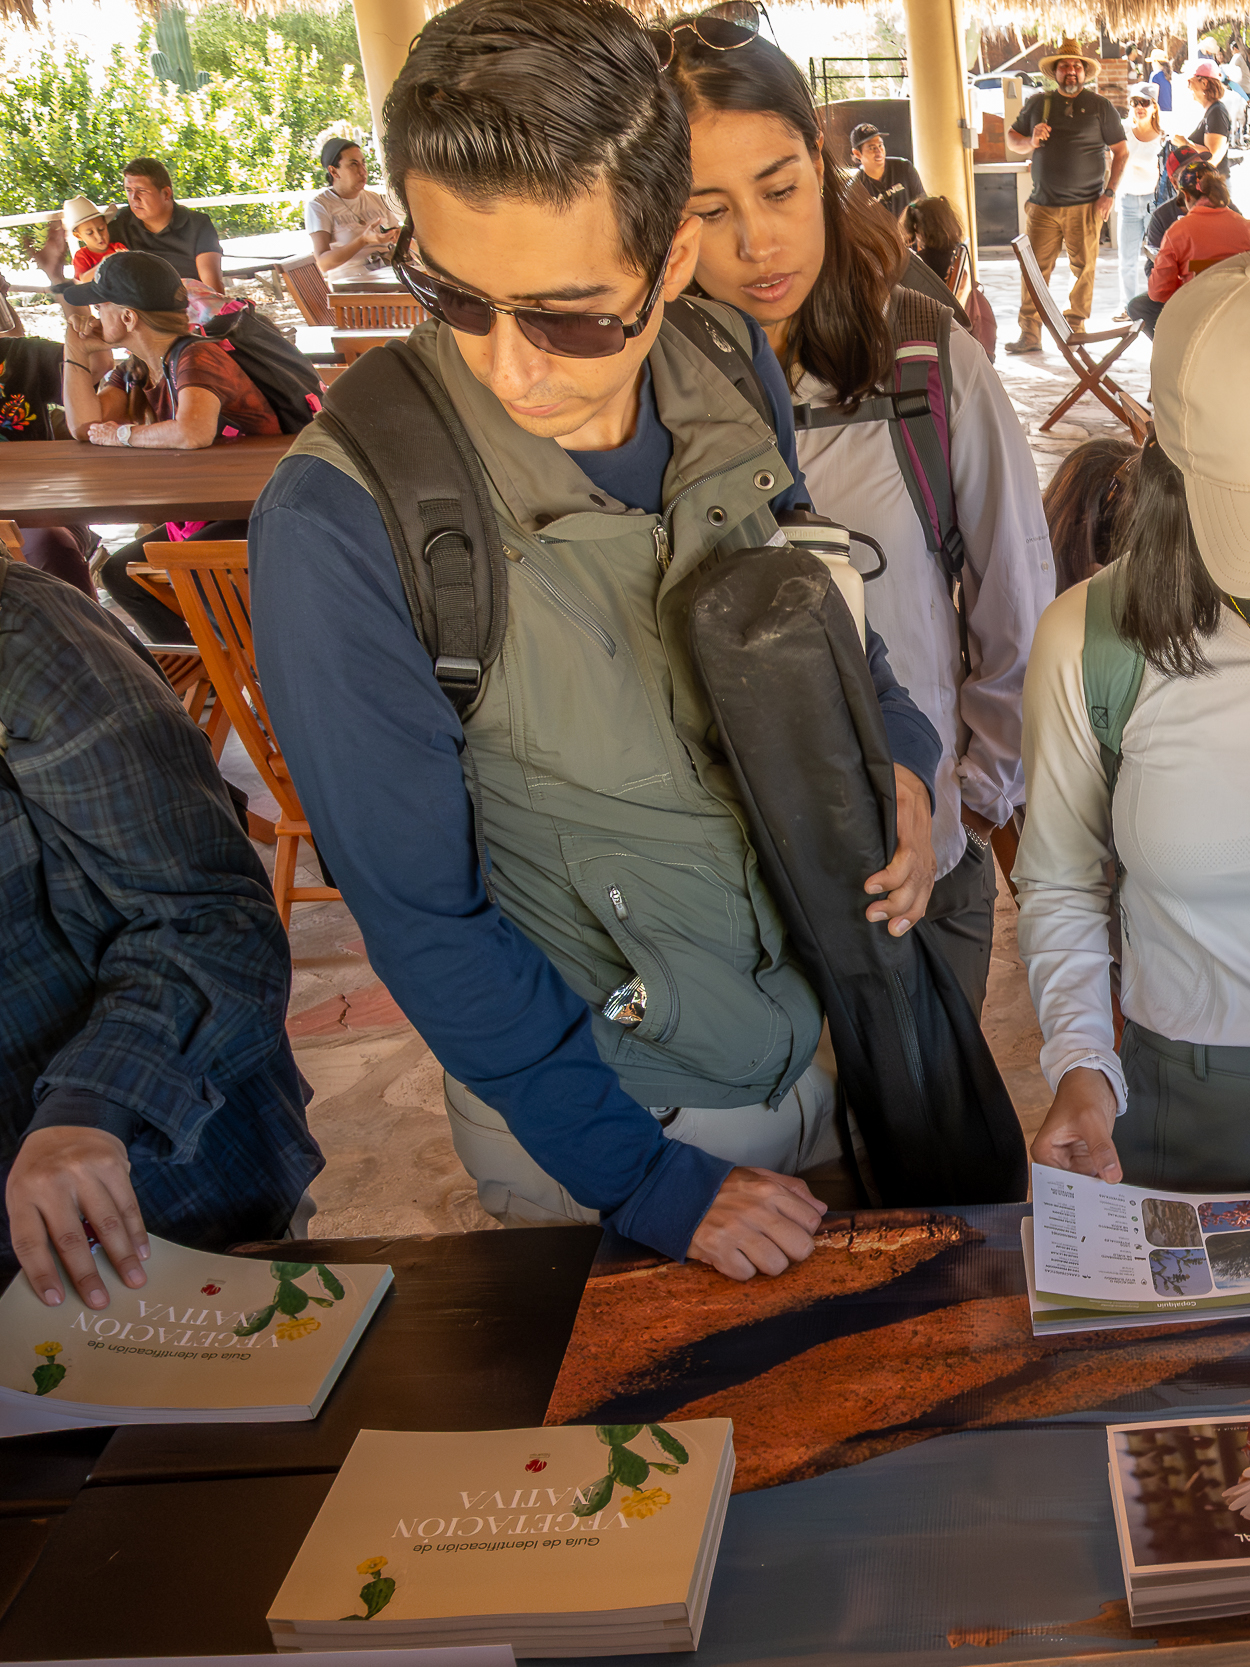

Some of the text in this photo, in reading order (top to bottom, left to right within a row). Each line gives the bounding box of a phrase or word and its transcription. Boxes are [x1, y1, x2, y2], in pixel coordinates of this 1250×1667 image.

[136, 1300, 257, 1328] NATIVA
[69, 1311, 280, 1348] VEGETACIÓN
[87, 1340, 252, 1361] Guía de Identificación de
[458, 1486, 594, 1510] NATIVA
[391, 1511, 630, 1544] VEGETACIÓN
[412, 1537, 601, 1555] Guía de Identificación de
